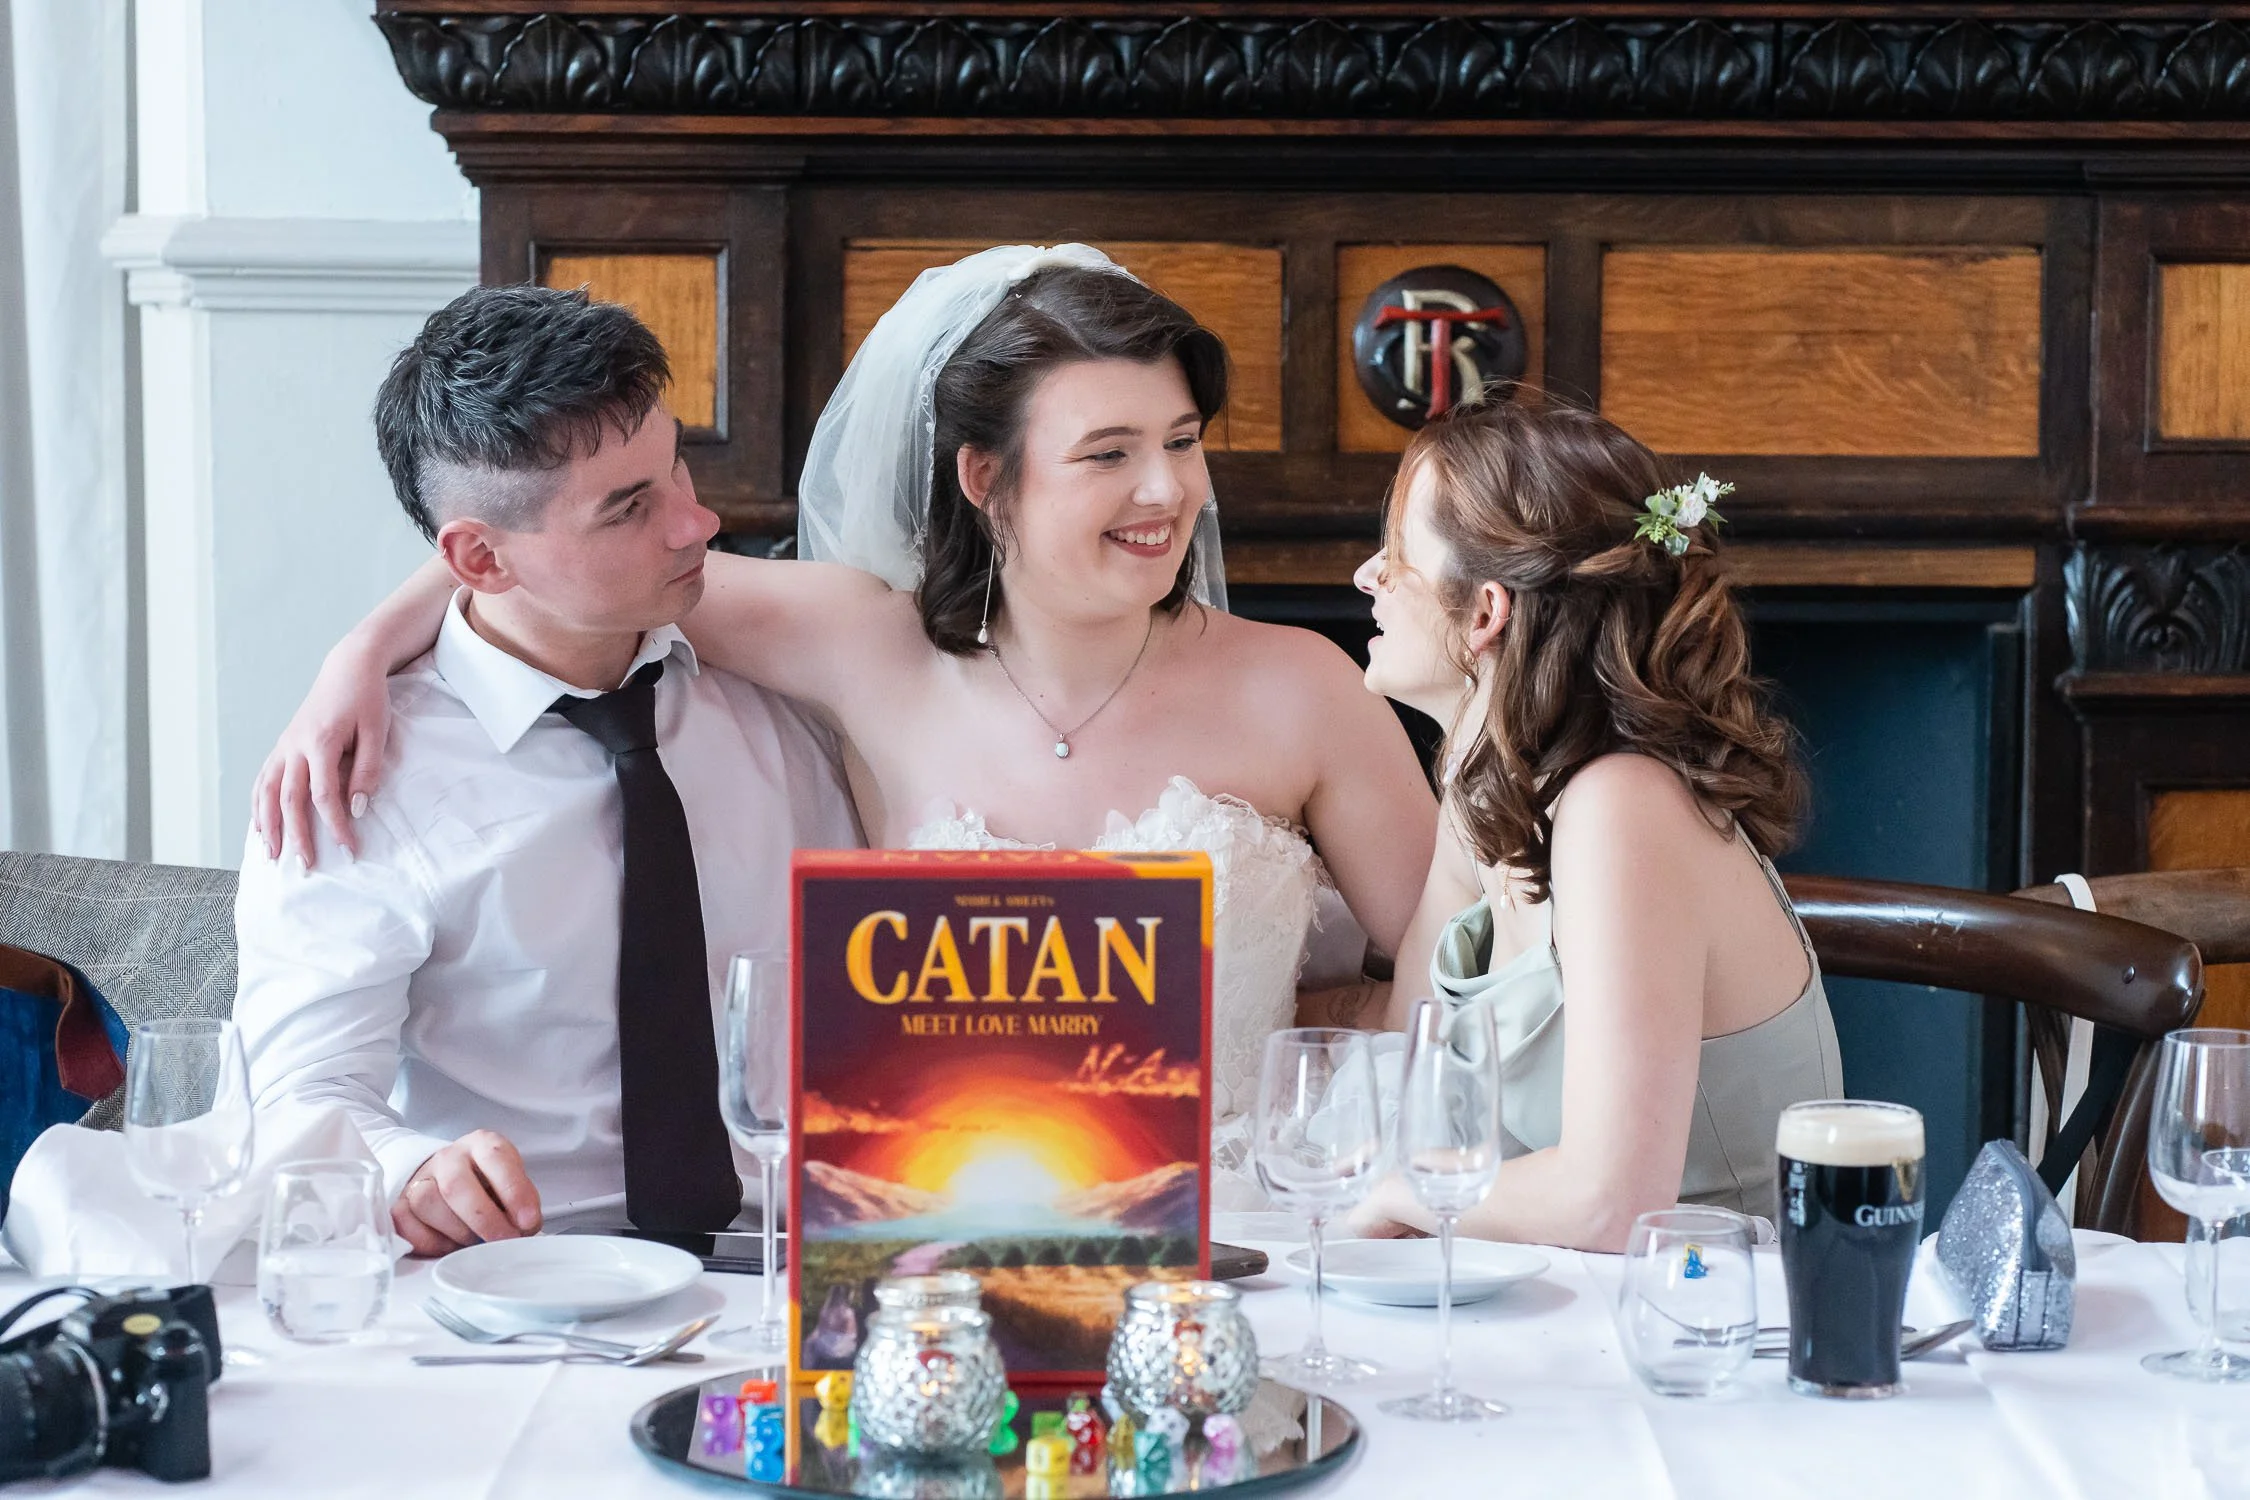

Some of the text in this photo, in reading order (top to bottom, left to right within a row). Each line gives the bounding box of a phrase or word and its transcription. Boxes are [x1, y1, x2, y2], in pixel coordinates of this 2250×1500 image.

[845, 909, 1164, 1005] CATAN
[901, 1013, 1103, 1036] MEET LOVE MARRY
